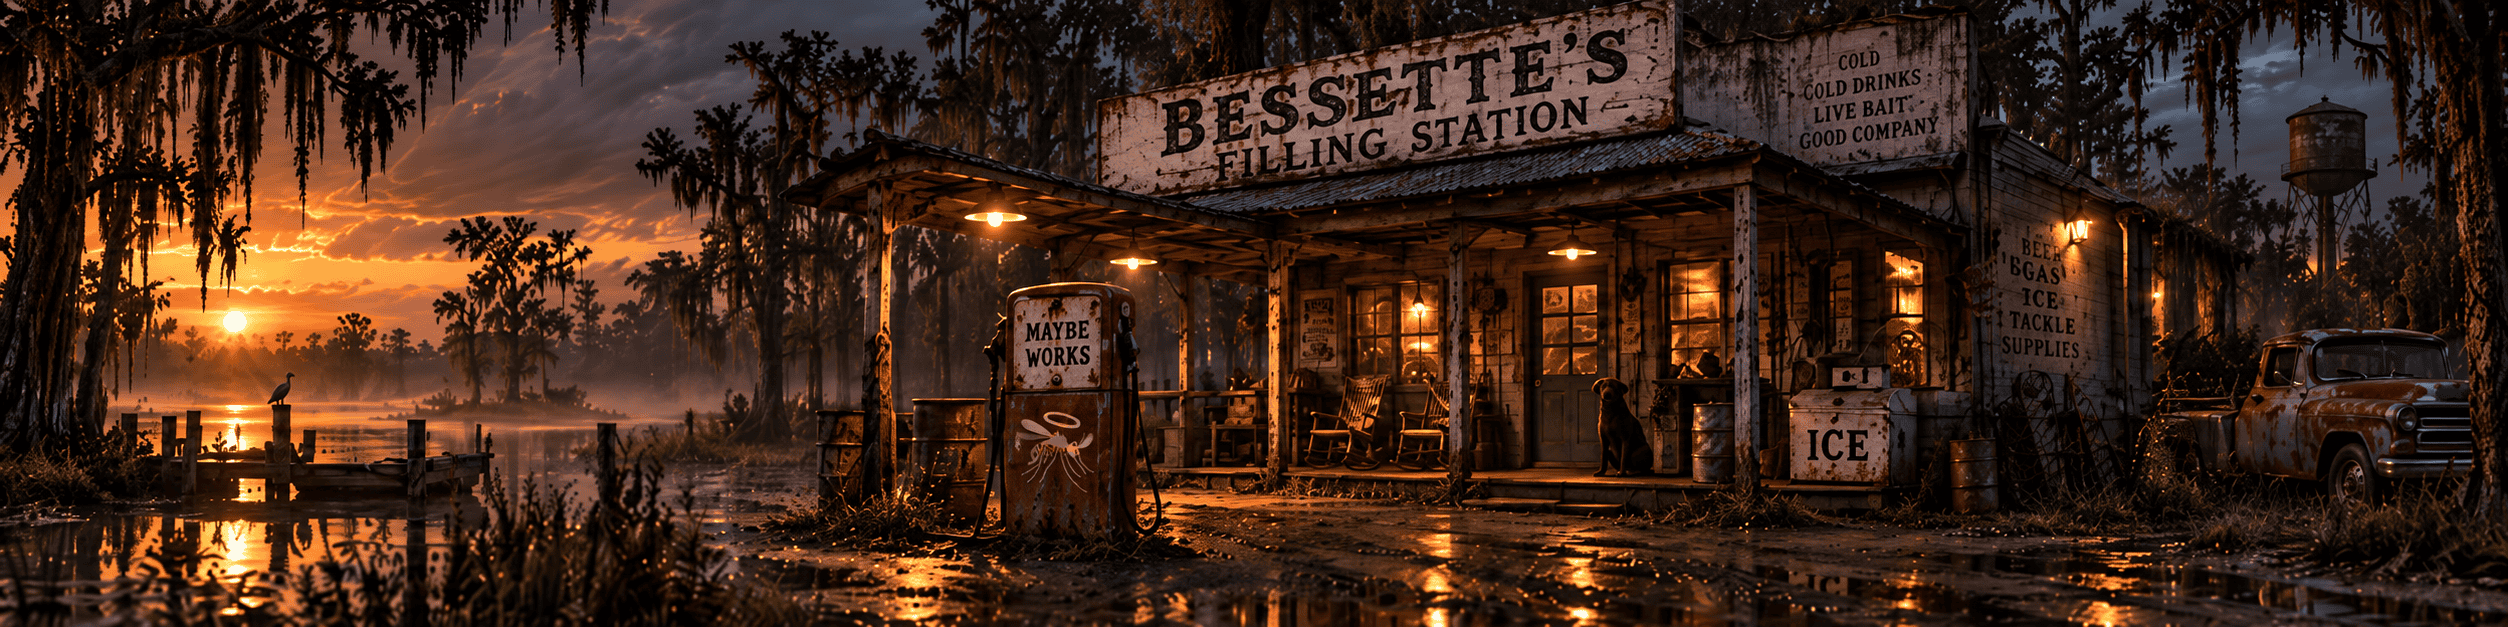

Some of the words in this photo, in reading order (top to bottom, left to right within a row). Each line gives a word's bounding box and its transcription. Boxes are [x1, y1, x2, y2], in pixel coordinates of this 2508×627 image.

[1838, 50, 1880, 71] COLD
[1161, 28, 1629, 158] BESSETTE'S
[1803, 80, 1847, 101] COLD
[1853, 68, 1921, 95] DRINKS
[1813, 103, 1857, 124] LIVE
[1216, 128, 1387, 181] FILLING
[1411, 96, 1589, 153] STATION
[1799, 129, 1847, 149] GOOD
[1852, 115, 1939, 143] COMPANY
[2022, 287, 2058, 310] ICE
[1025, 320, 1090, 342] MAYBE
[2009, 311, 2075, 335] TACKLE
[1025, 345, 1091, 368] WORKS
[2002, 336, 2079, 359] SUPPLIES
[1807, 429, 1869, 461] ICE
